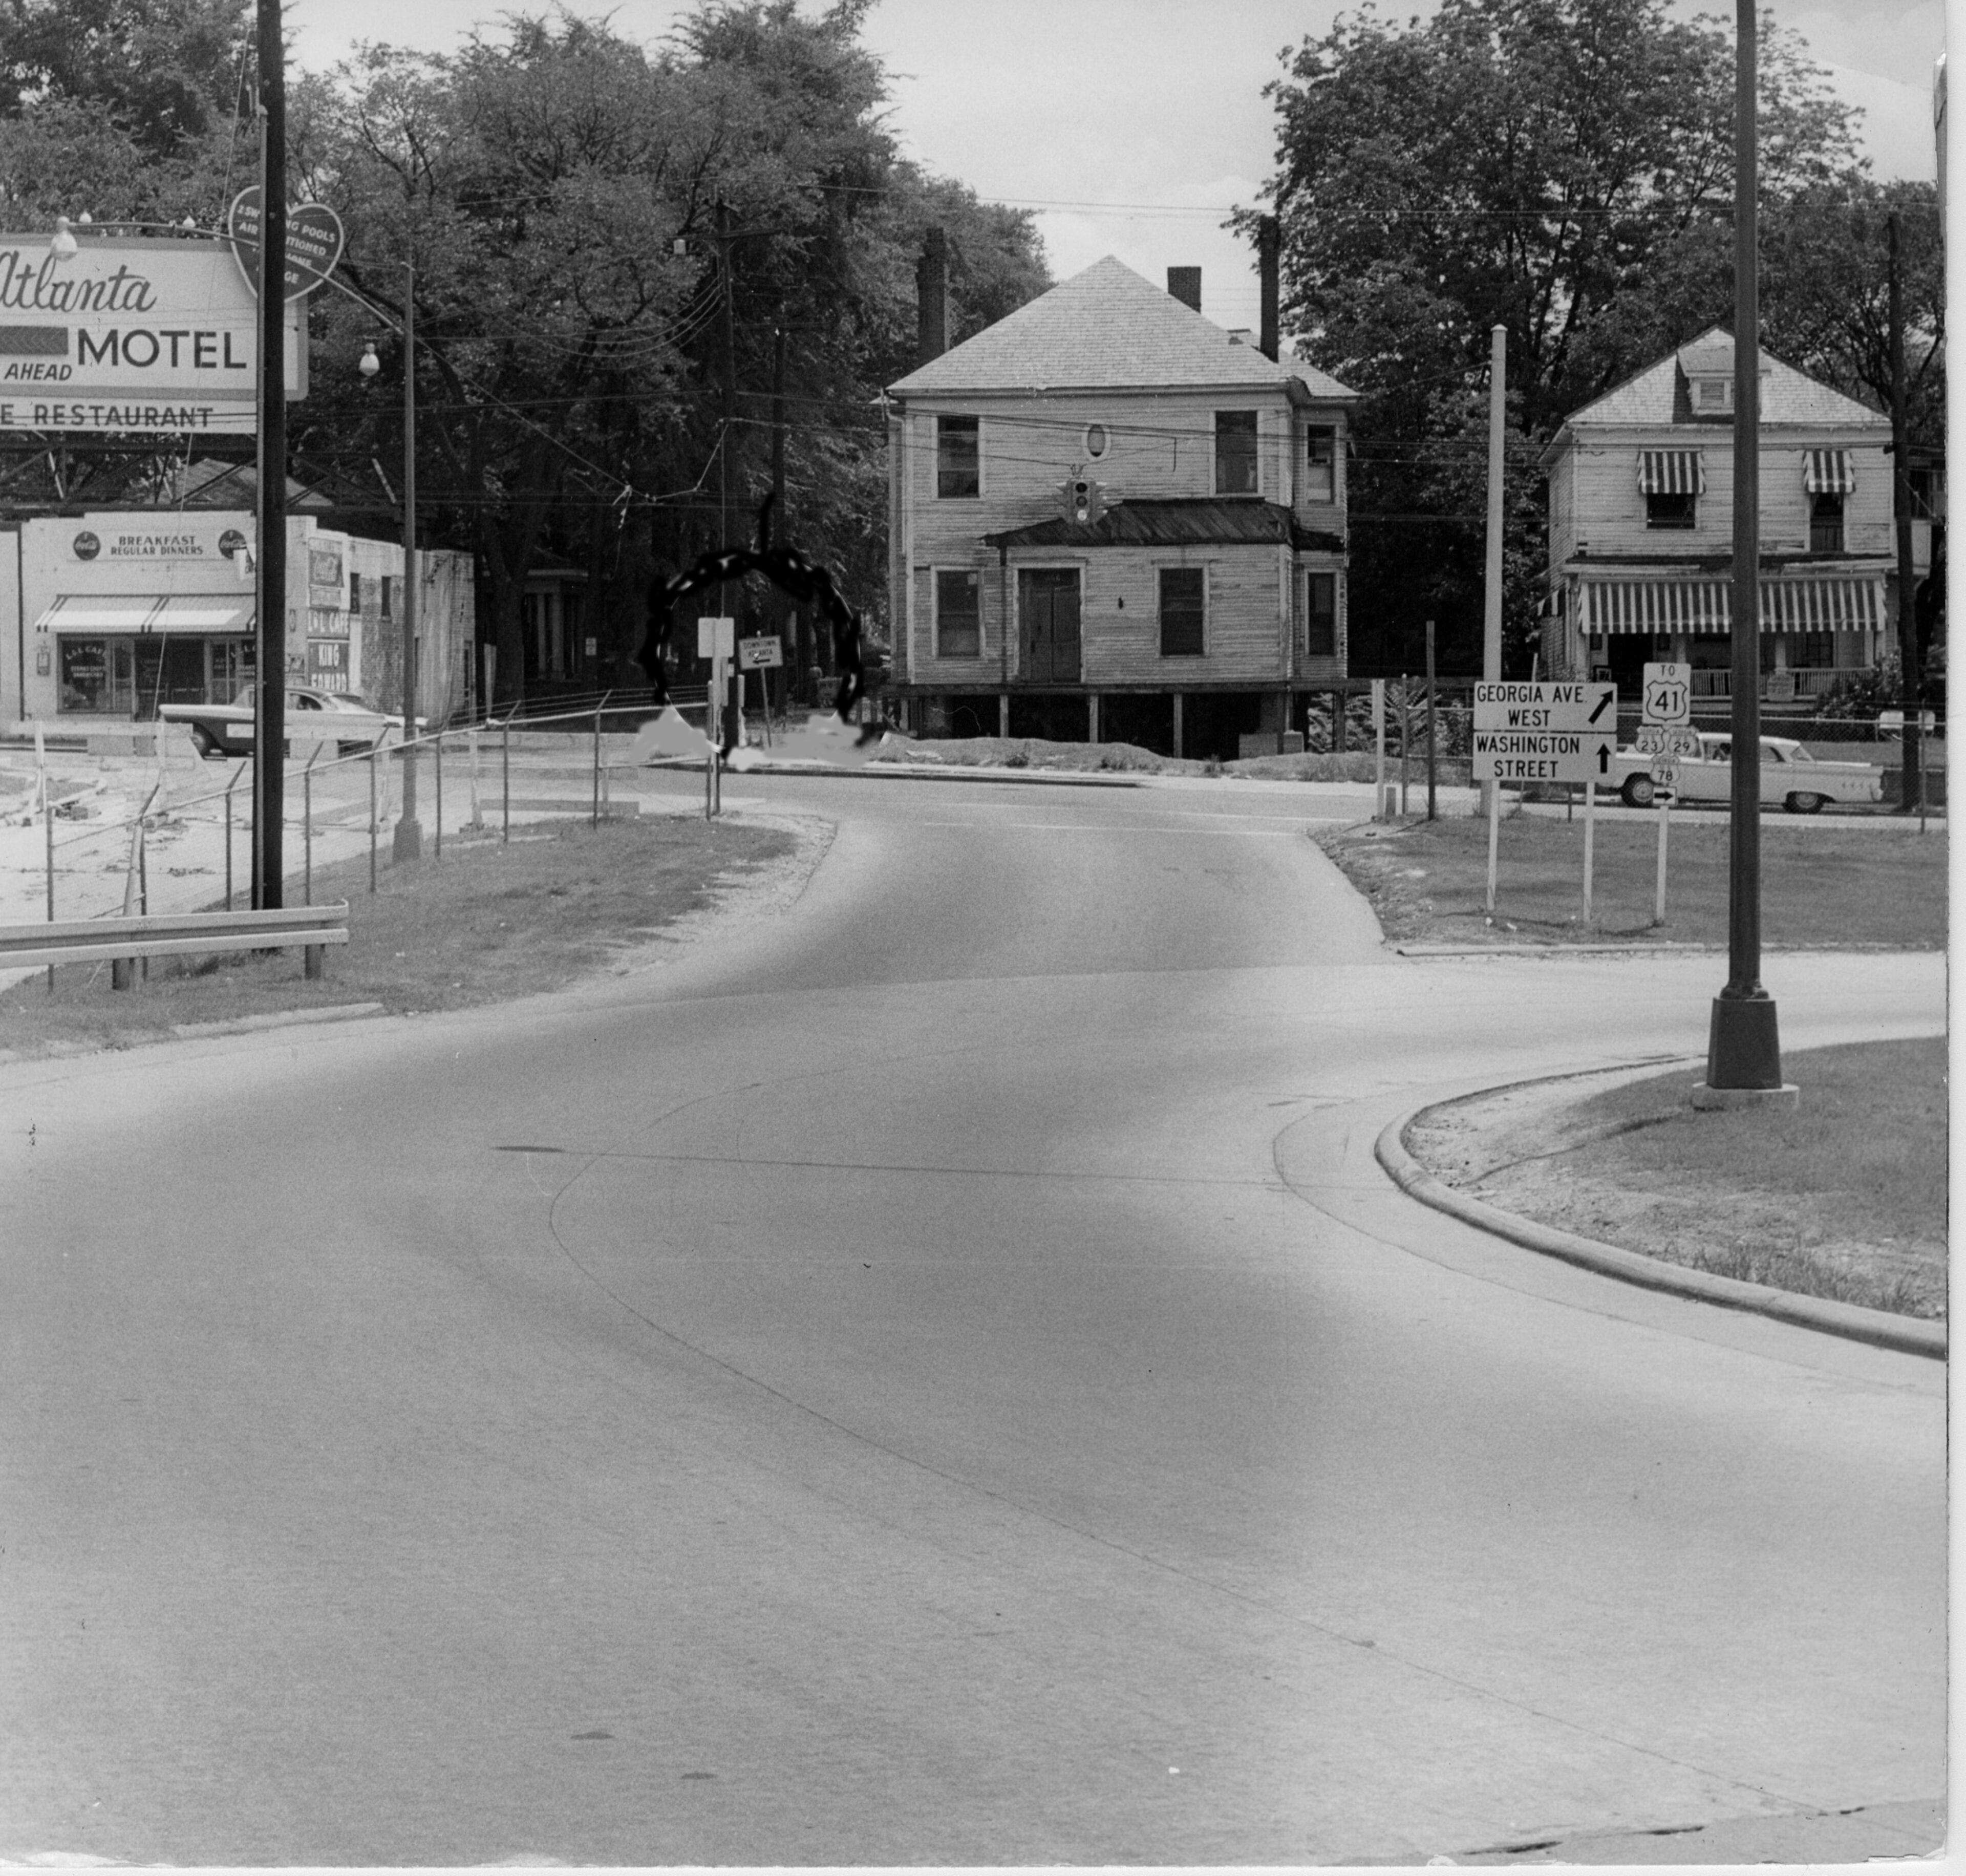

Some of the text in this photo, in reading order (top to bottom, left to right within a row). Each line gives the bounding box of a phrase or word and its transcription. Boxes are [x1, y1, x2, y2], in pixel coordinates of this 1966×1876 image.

[239, 221, 258, 235] AIR
[302, 224, 336, 243] POOLS
[0, 250, 157, 312] Atlanta
[78, 328, 247, 369] MOTEL
[4, 363, 73, 381] AHEAD
[34, 404, 213, 427] RESTAURANT
[119, 536, 196, 546] BREAKFAST
[111, 546, 203, 556] REGULAR DINNERS
[743, 639, 777, 650] DOWNTOWN
[748, 648, 773, 657] ATANTA
[318, 644, 339, 667] KING
[1660, 665, 1675, 676] TO
[1477, 685, 1543, 702] GEORGIA
[1655, 690, 1677, 711] 41
[1508, 710, 1550, 727] WEST
[1477, 736, 1580, 754] WASHINGTON
[1641, 740, 1658, 752] 23
[1674, 741, 1690, 752] 29
[1494, 760, 1558, 778] STREET
[1658, 770, 1673, 781] 78
